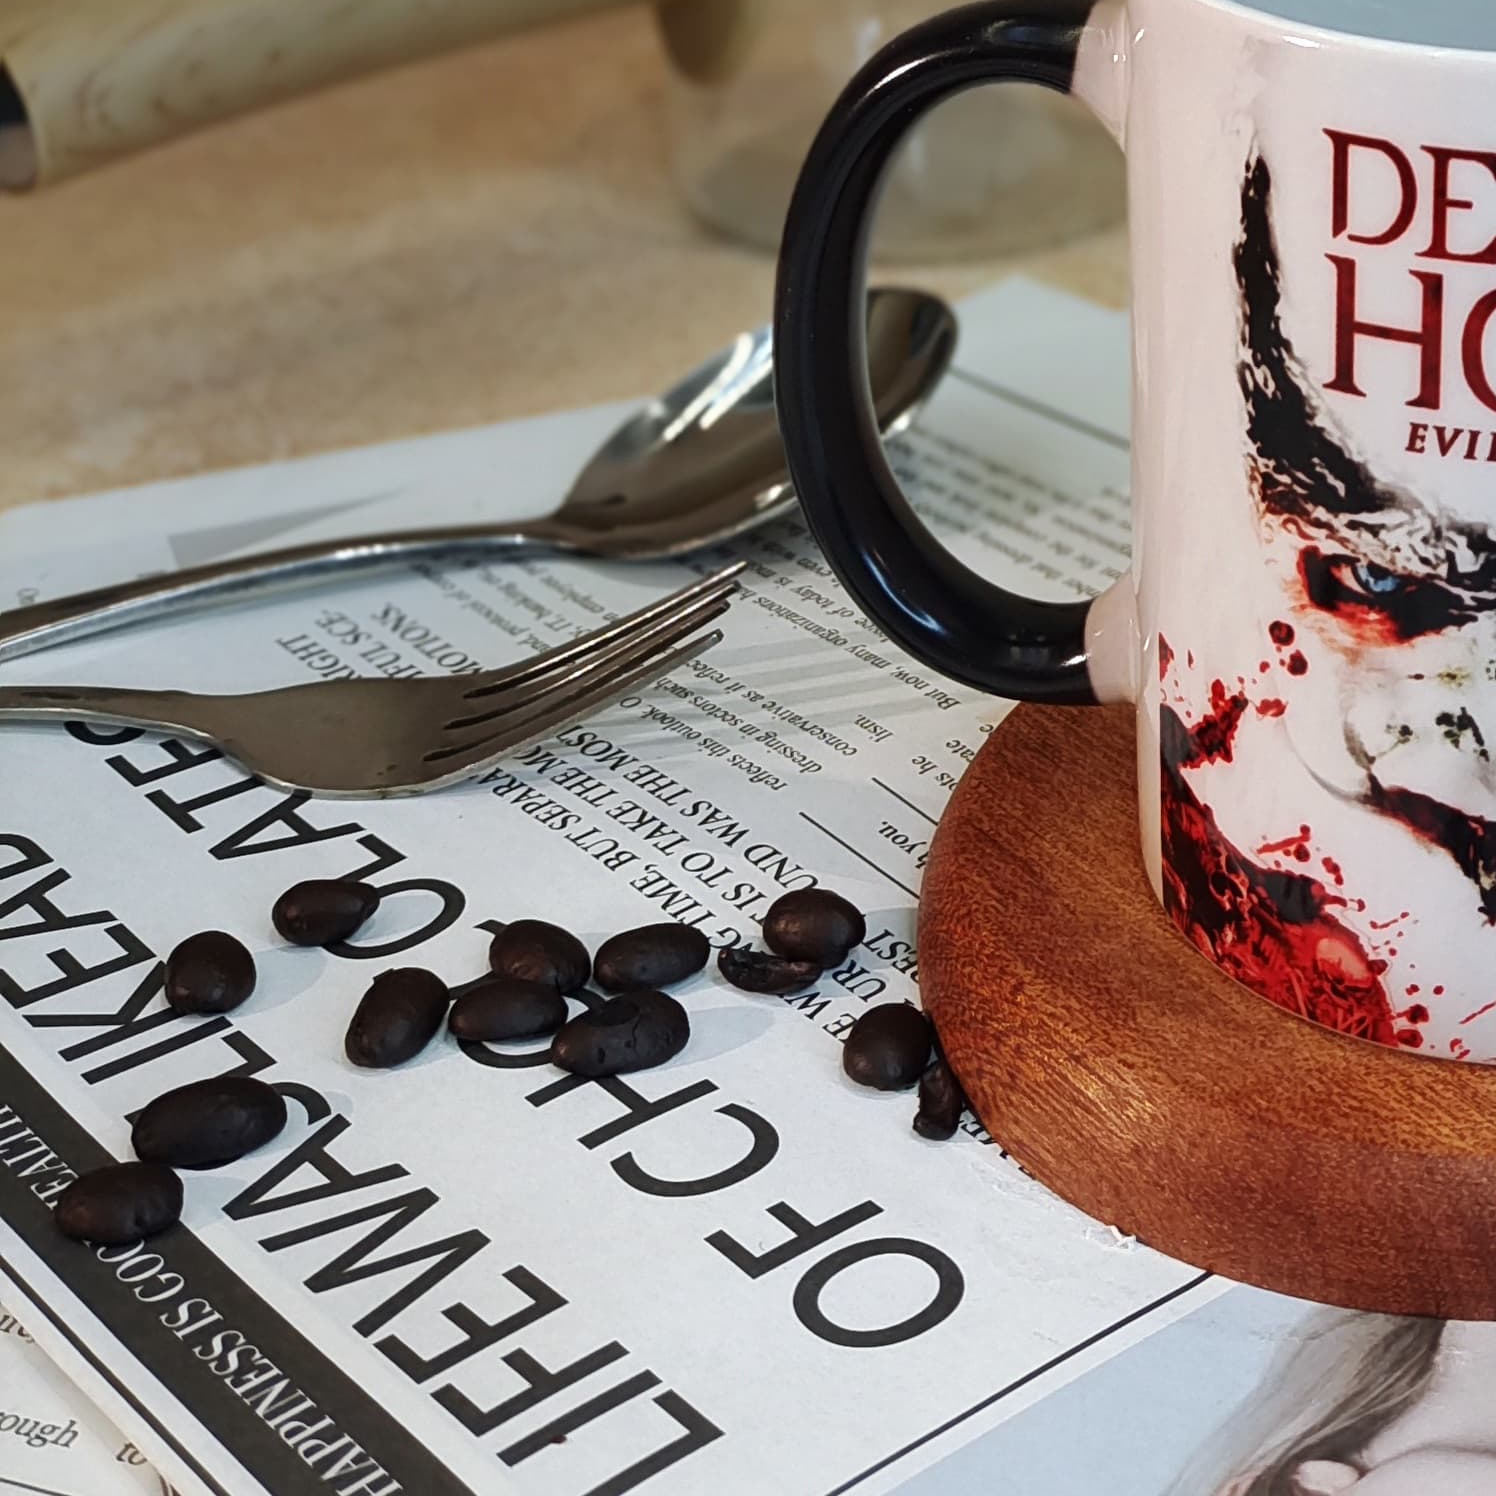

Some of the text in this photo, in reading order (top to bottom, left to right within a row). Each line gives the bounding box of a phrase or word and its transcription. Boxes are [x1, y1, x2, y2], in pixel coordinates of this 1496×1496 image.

[753, 595, 849, 646] organizations
[846, 643, 892, 670] many
[742, 689, 764, 703] as
[890, 665, 931, 691] now,
[693, 695, 745, 727] sectors
[924, 689, 961, 710] But
[698, 736, 731, 758] this
[739, 722, 761, 740] in
[761, 699, 858, 757] conservative
[727, 752, 789, 791] reflects
[756, 730, 822, 775] dressing
[912, 755, 939, 775] he
[550, 766, 619, 807] THE
[623, 764, 692, 805] THE
[606, 800, 690, 856] TAKE
[680, 800, 750, 848] WAS
[878, 820, 927, 855] you.
[564, 826, 641, 873] BUT
[681, 851, 733, 889] TO
[629, 863, 717, 928] TIME,
[722, 881, 769, 911] IS
[704, 1199, 965, 1348] OF
[160, 1297, 224, 1342] IS
[193, 1328, 404, 1496] HAPPINESS
